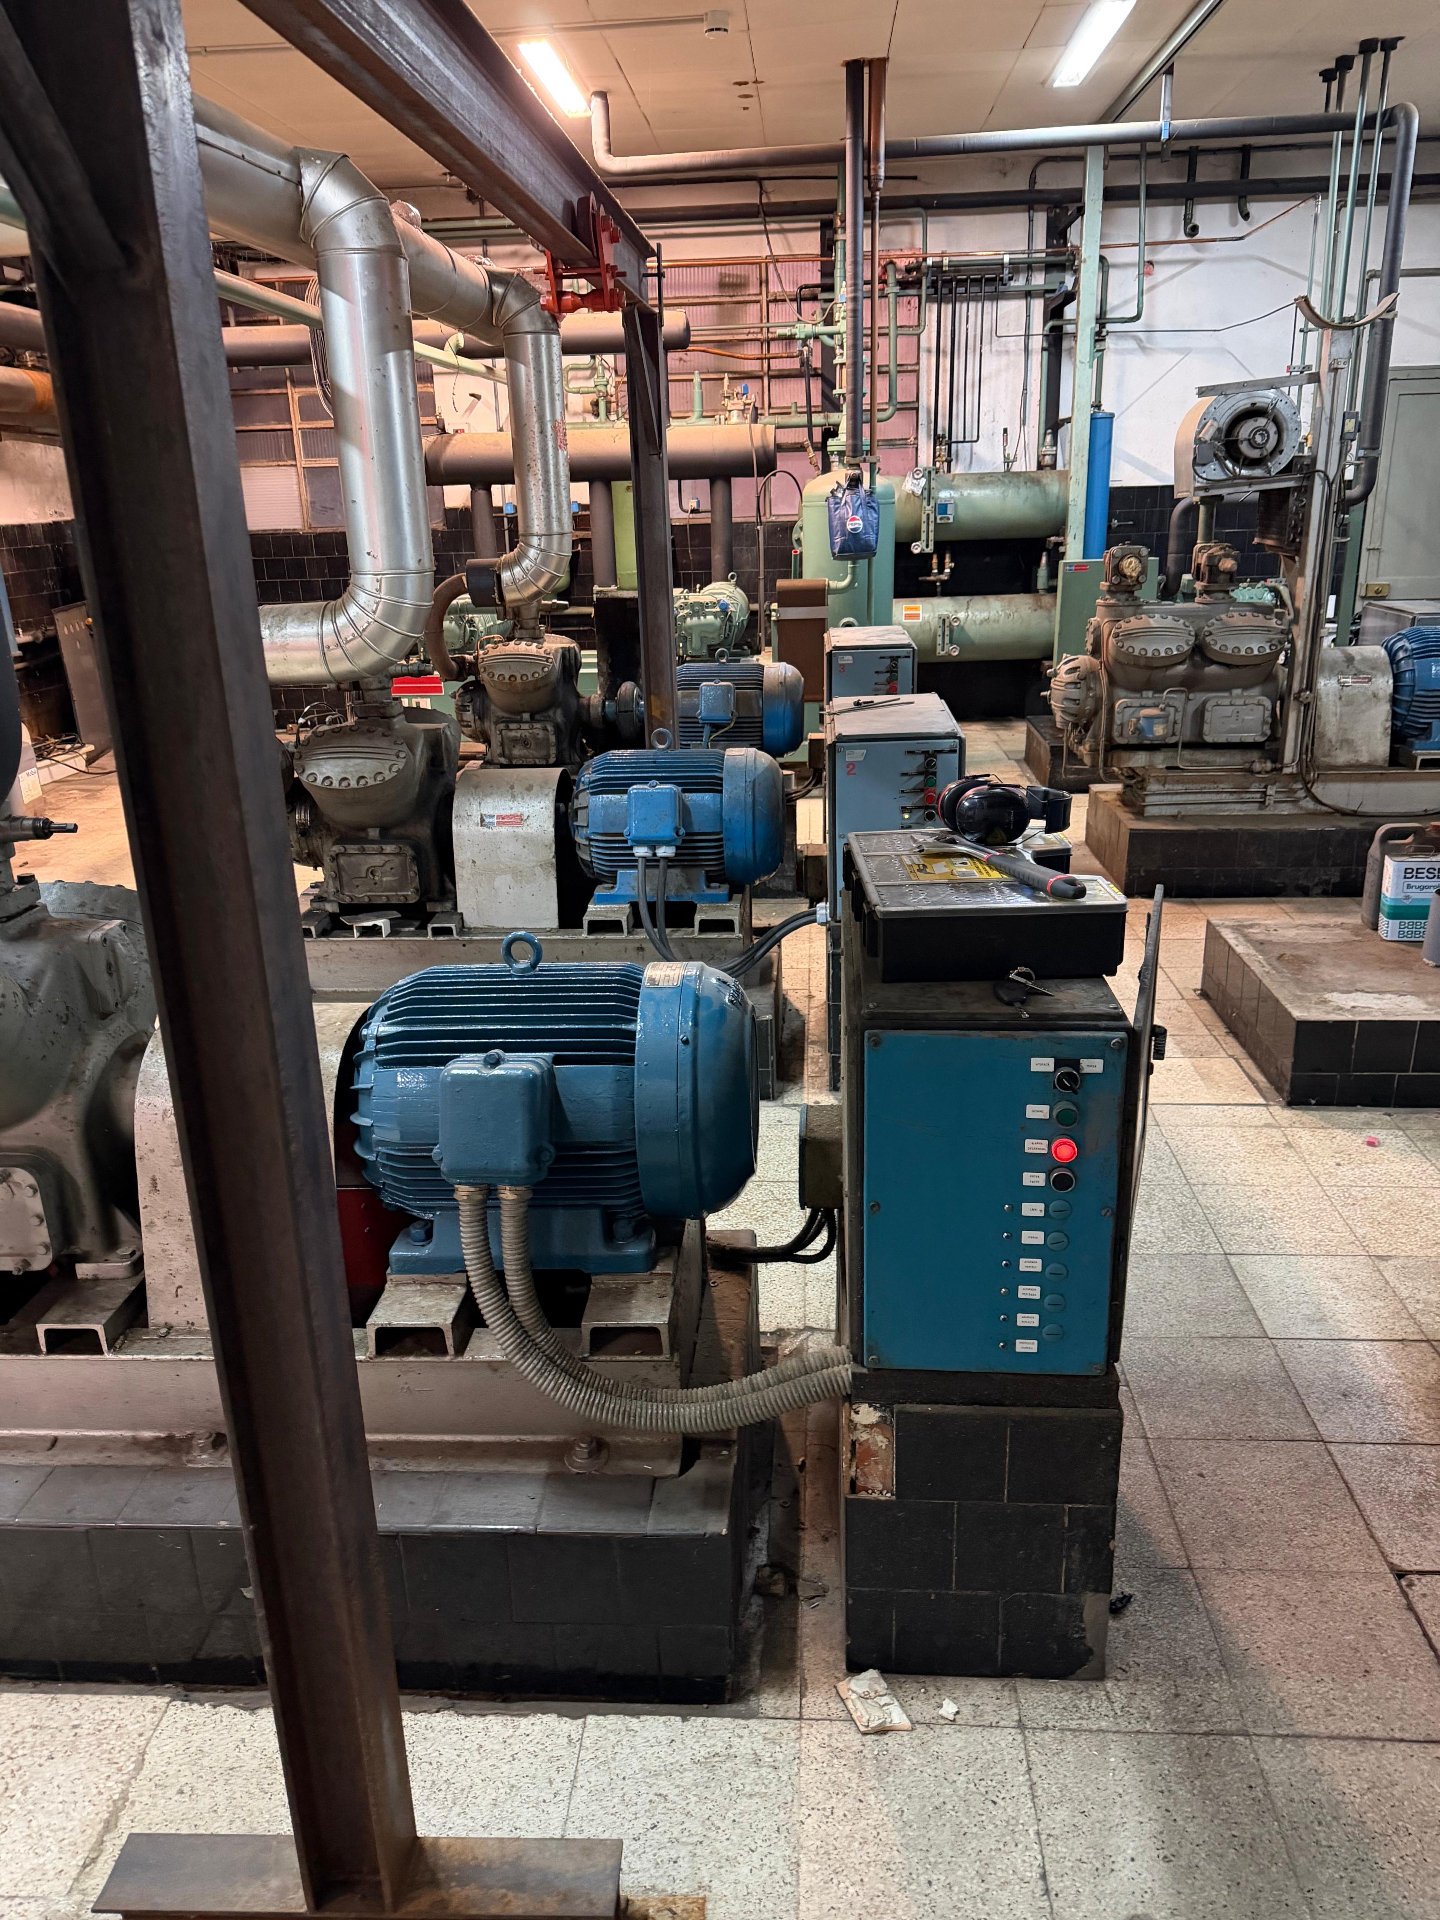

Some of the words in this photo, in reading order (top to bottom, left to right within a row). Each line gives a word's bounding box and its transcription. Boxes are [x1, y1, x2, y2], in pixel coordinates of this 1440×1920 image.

[839, 664, 846, 673] 3
[846, 762, 856, 776] 2
[1403, 867, 1440, 879] BES
